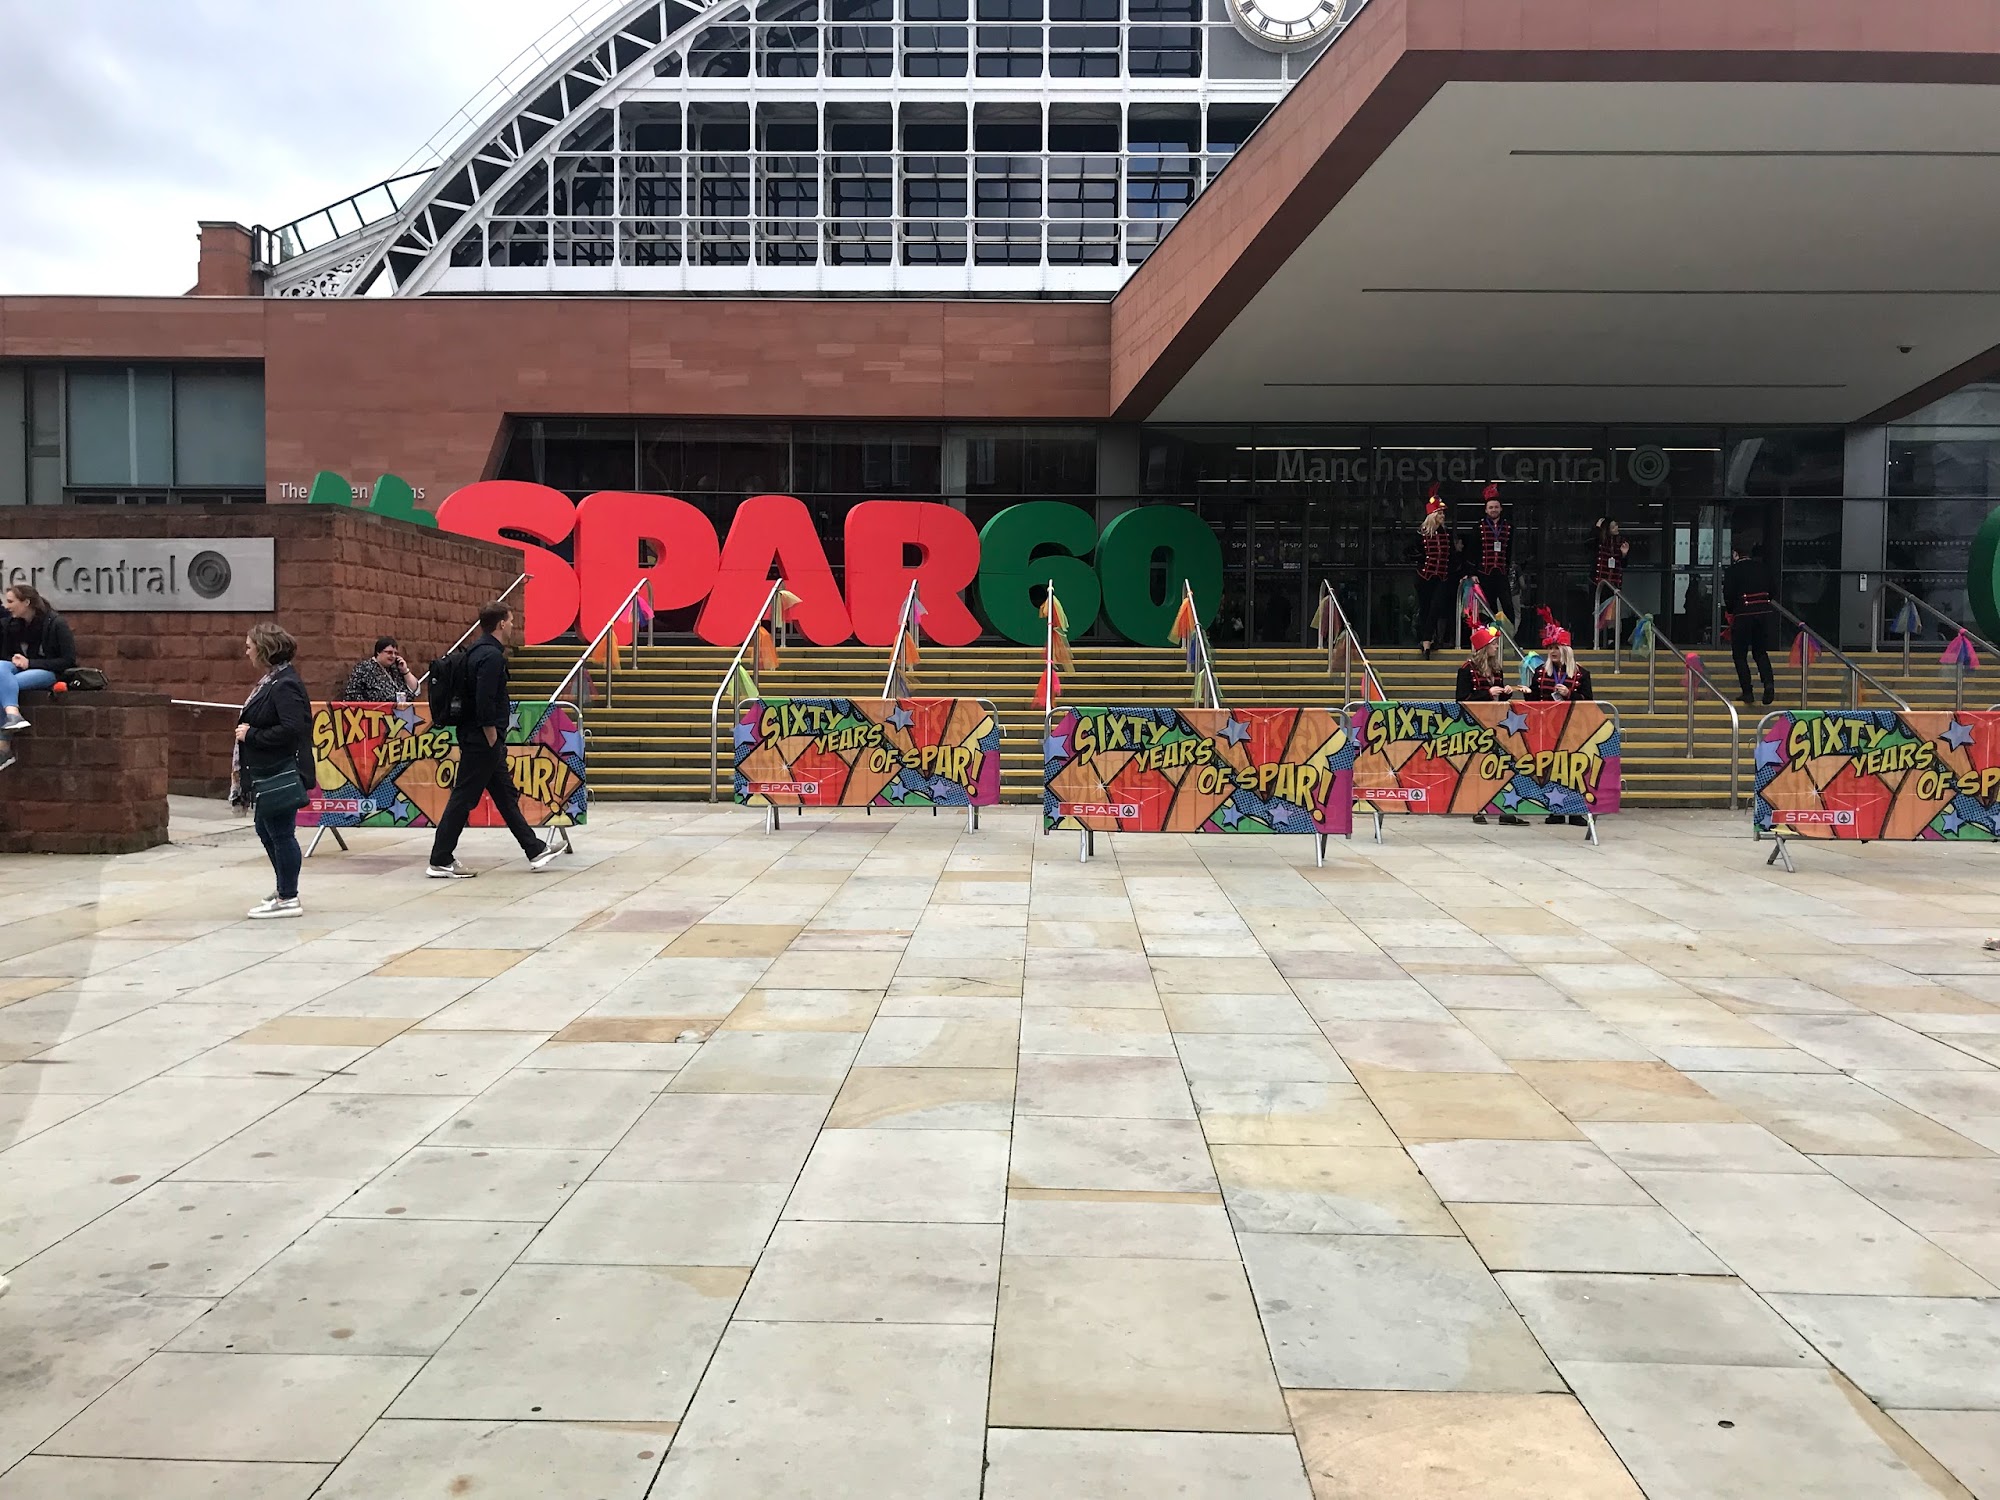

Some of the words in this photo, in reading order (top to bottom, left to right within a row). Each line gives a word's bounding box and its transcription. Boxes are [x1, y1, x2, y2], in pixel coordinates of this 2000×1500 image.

[1275, 449, 1484, 482] Manchester
[1495, 449, 1620, 482] Central
[279, 482, 308, 499] The
[52, 554, 180, 595] Central
[312, 707, 407, 762] SIXTY
[759, 703, 844, 749] SIXTY
[814, 723, 885, 754] YEARS
[1073, 712, 1170, 765] SIXTY
[1367, 706, 1454, 754] SIXTY
[1422, 728, 1497, 760] YEARS
[373, 731, 452, 767] YEARS
[1133, 737, 1215, 773] YEARS
[1788, 716, 1888, 773] SIXTY
[1851, 741, 1937, 778] YEARS
[435, 759, 460, 790] O
[760, 784, 801, 793] SPAR
[869, 750, 899, 774] OF
[902, 745, 984, 797] SPAR!
[1480, 755, 1512, 780] OF
[1514, 750, 1604, 804] SPAR!
[1916, 770, 1953, 800] OF
[1956, 767, 2000, 801] SP
[312, 801, 357, 811] SPAR
[1072, 804, 1119, 815] SPAR
[1197, 766, 1232, 795] OF
[1236, 762, 1334, 824] SPAR!
[1365, 790, 1408, 799] SPAR
[1785, 812, 1834, 822] SPAR
